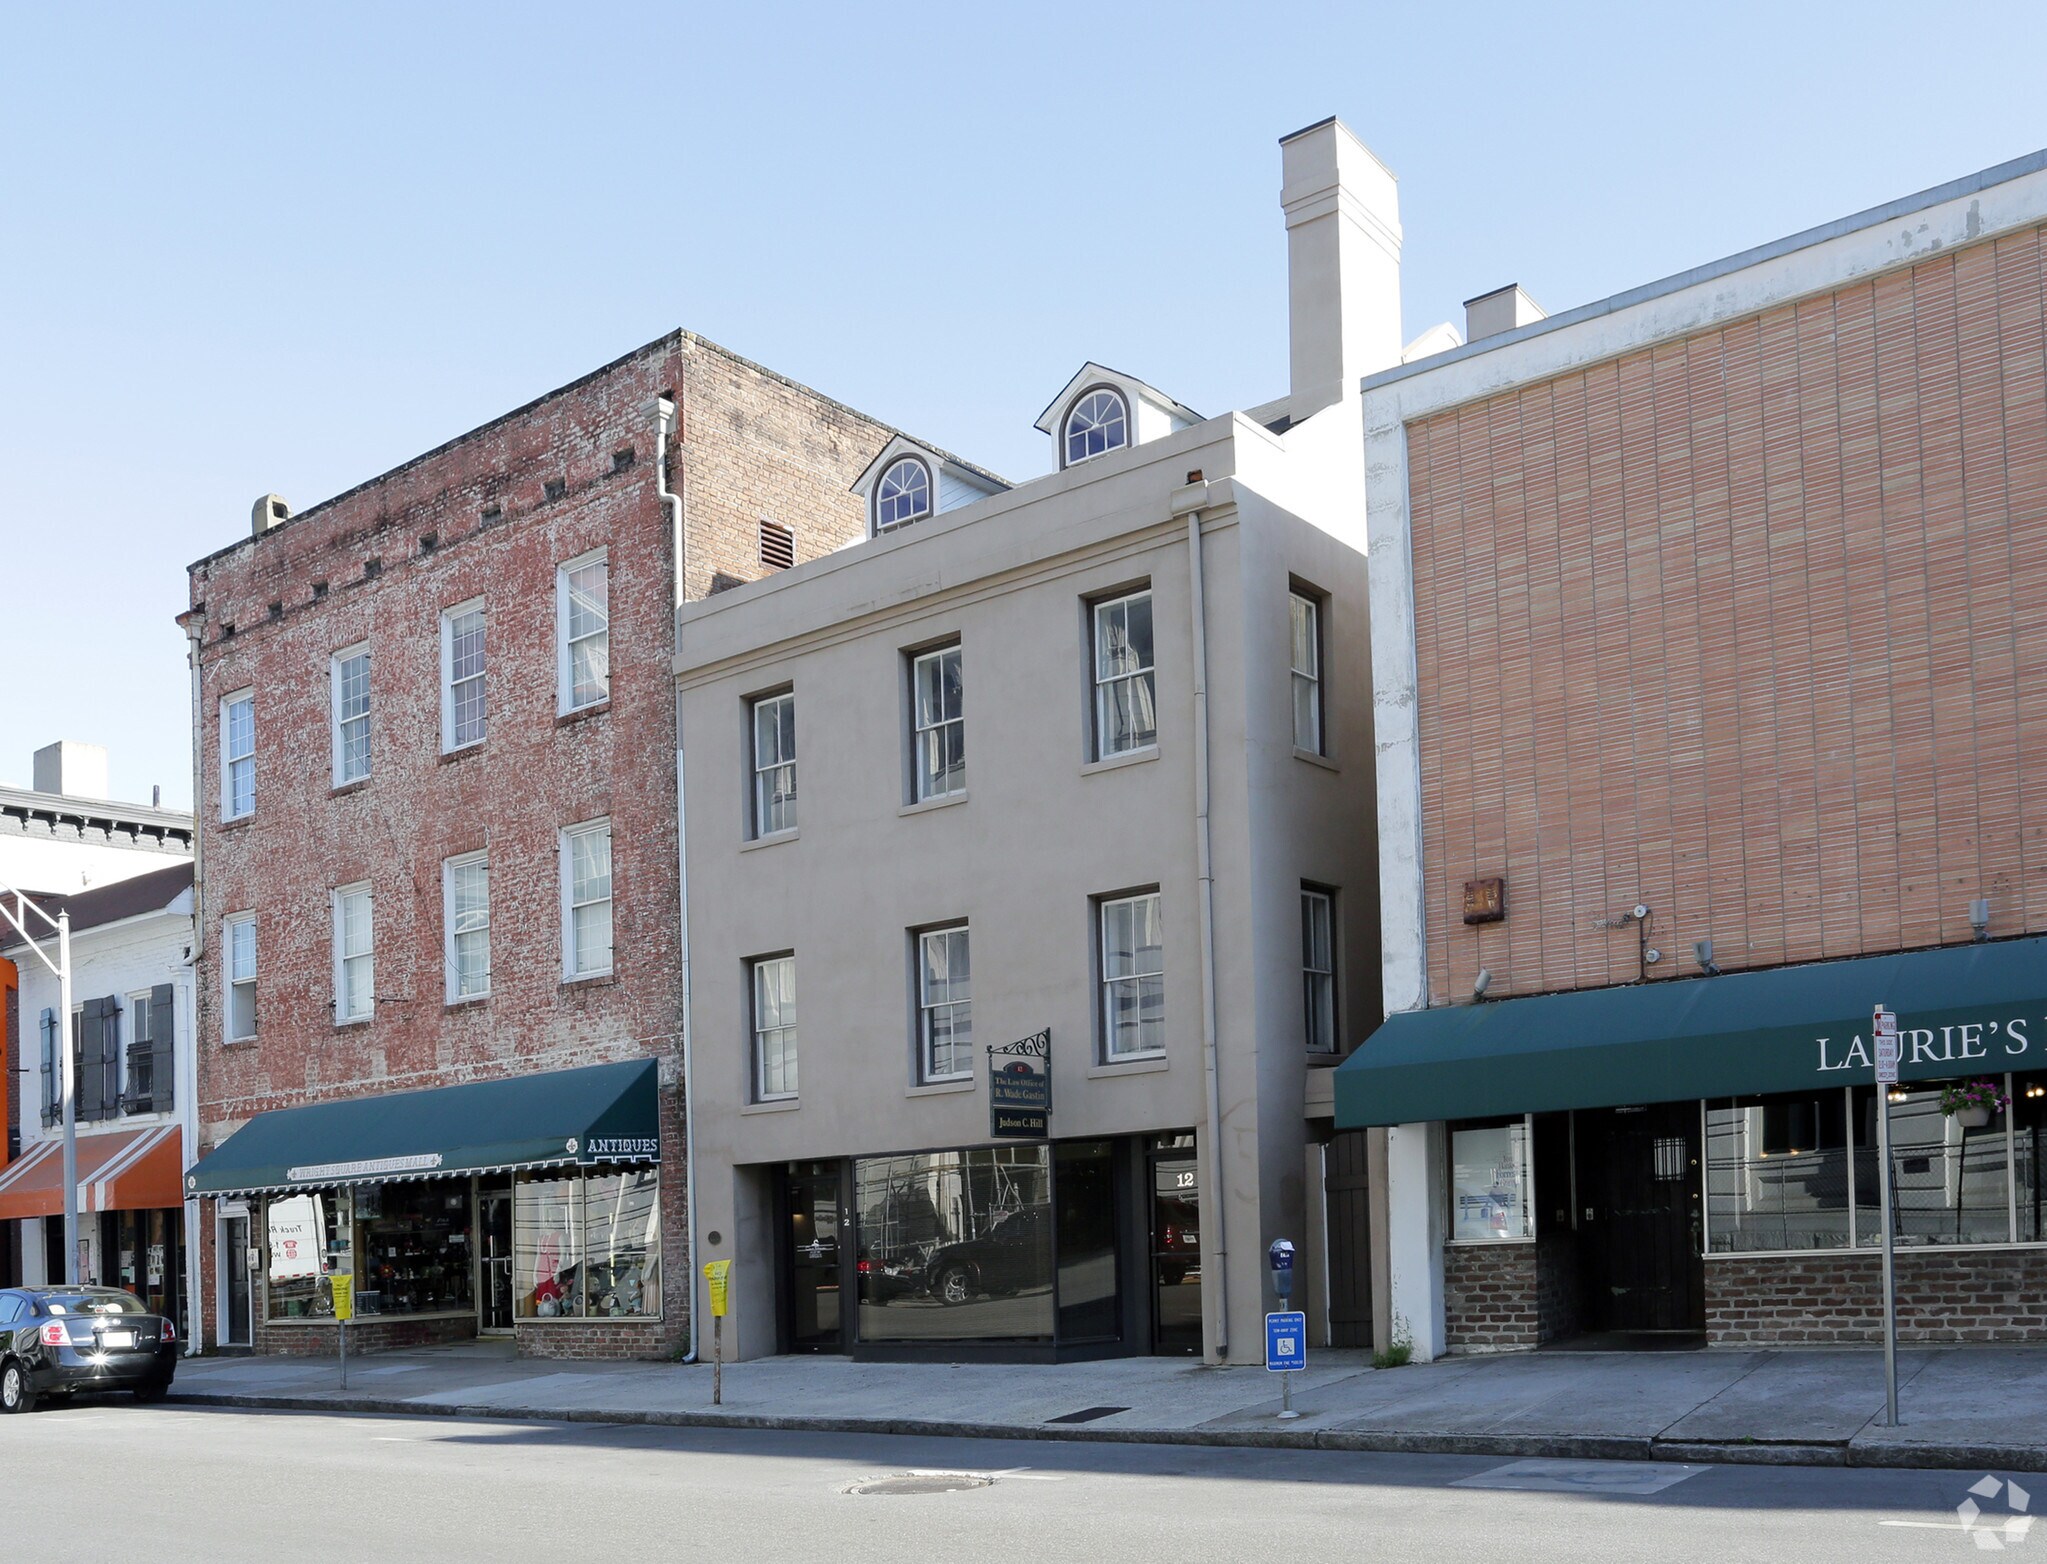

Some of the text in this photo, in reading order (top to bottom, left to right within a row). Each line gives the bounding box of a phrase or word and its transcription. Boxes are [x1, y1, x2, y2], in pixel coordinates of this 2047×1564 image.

[995, 1077, 1045, 1088] The Law Office of
[1004, 1088, 1021, 1098] Wade
[999, 1117, 1043, 1128] Judson C. Hill
[587, 1139, 658, 1153] ANTIQUES
[299, 1156, 428, 1178] WRIGHT SQUARE ANTIQUES MALL
[1177, 1172, 1194, 1187] 12
